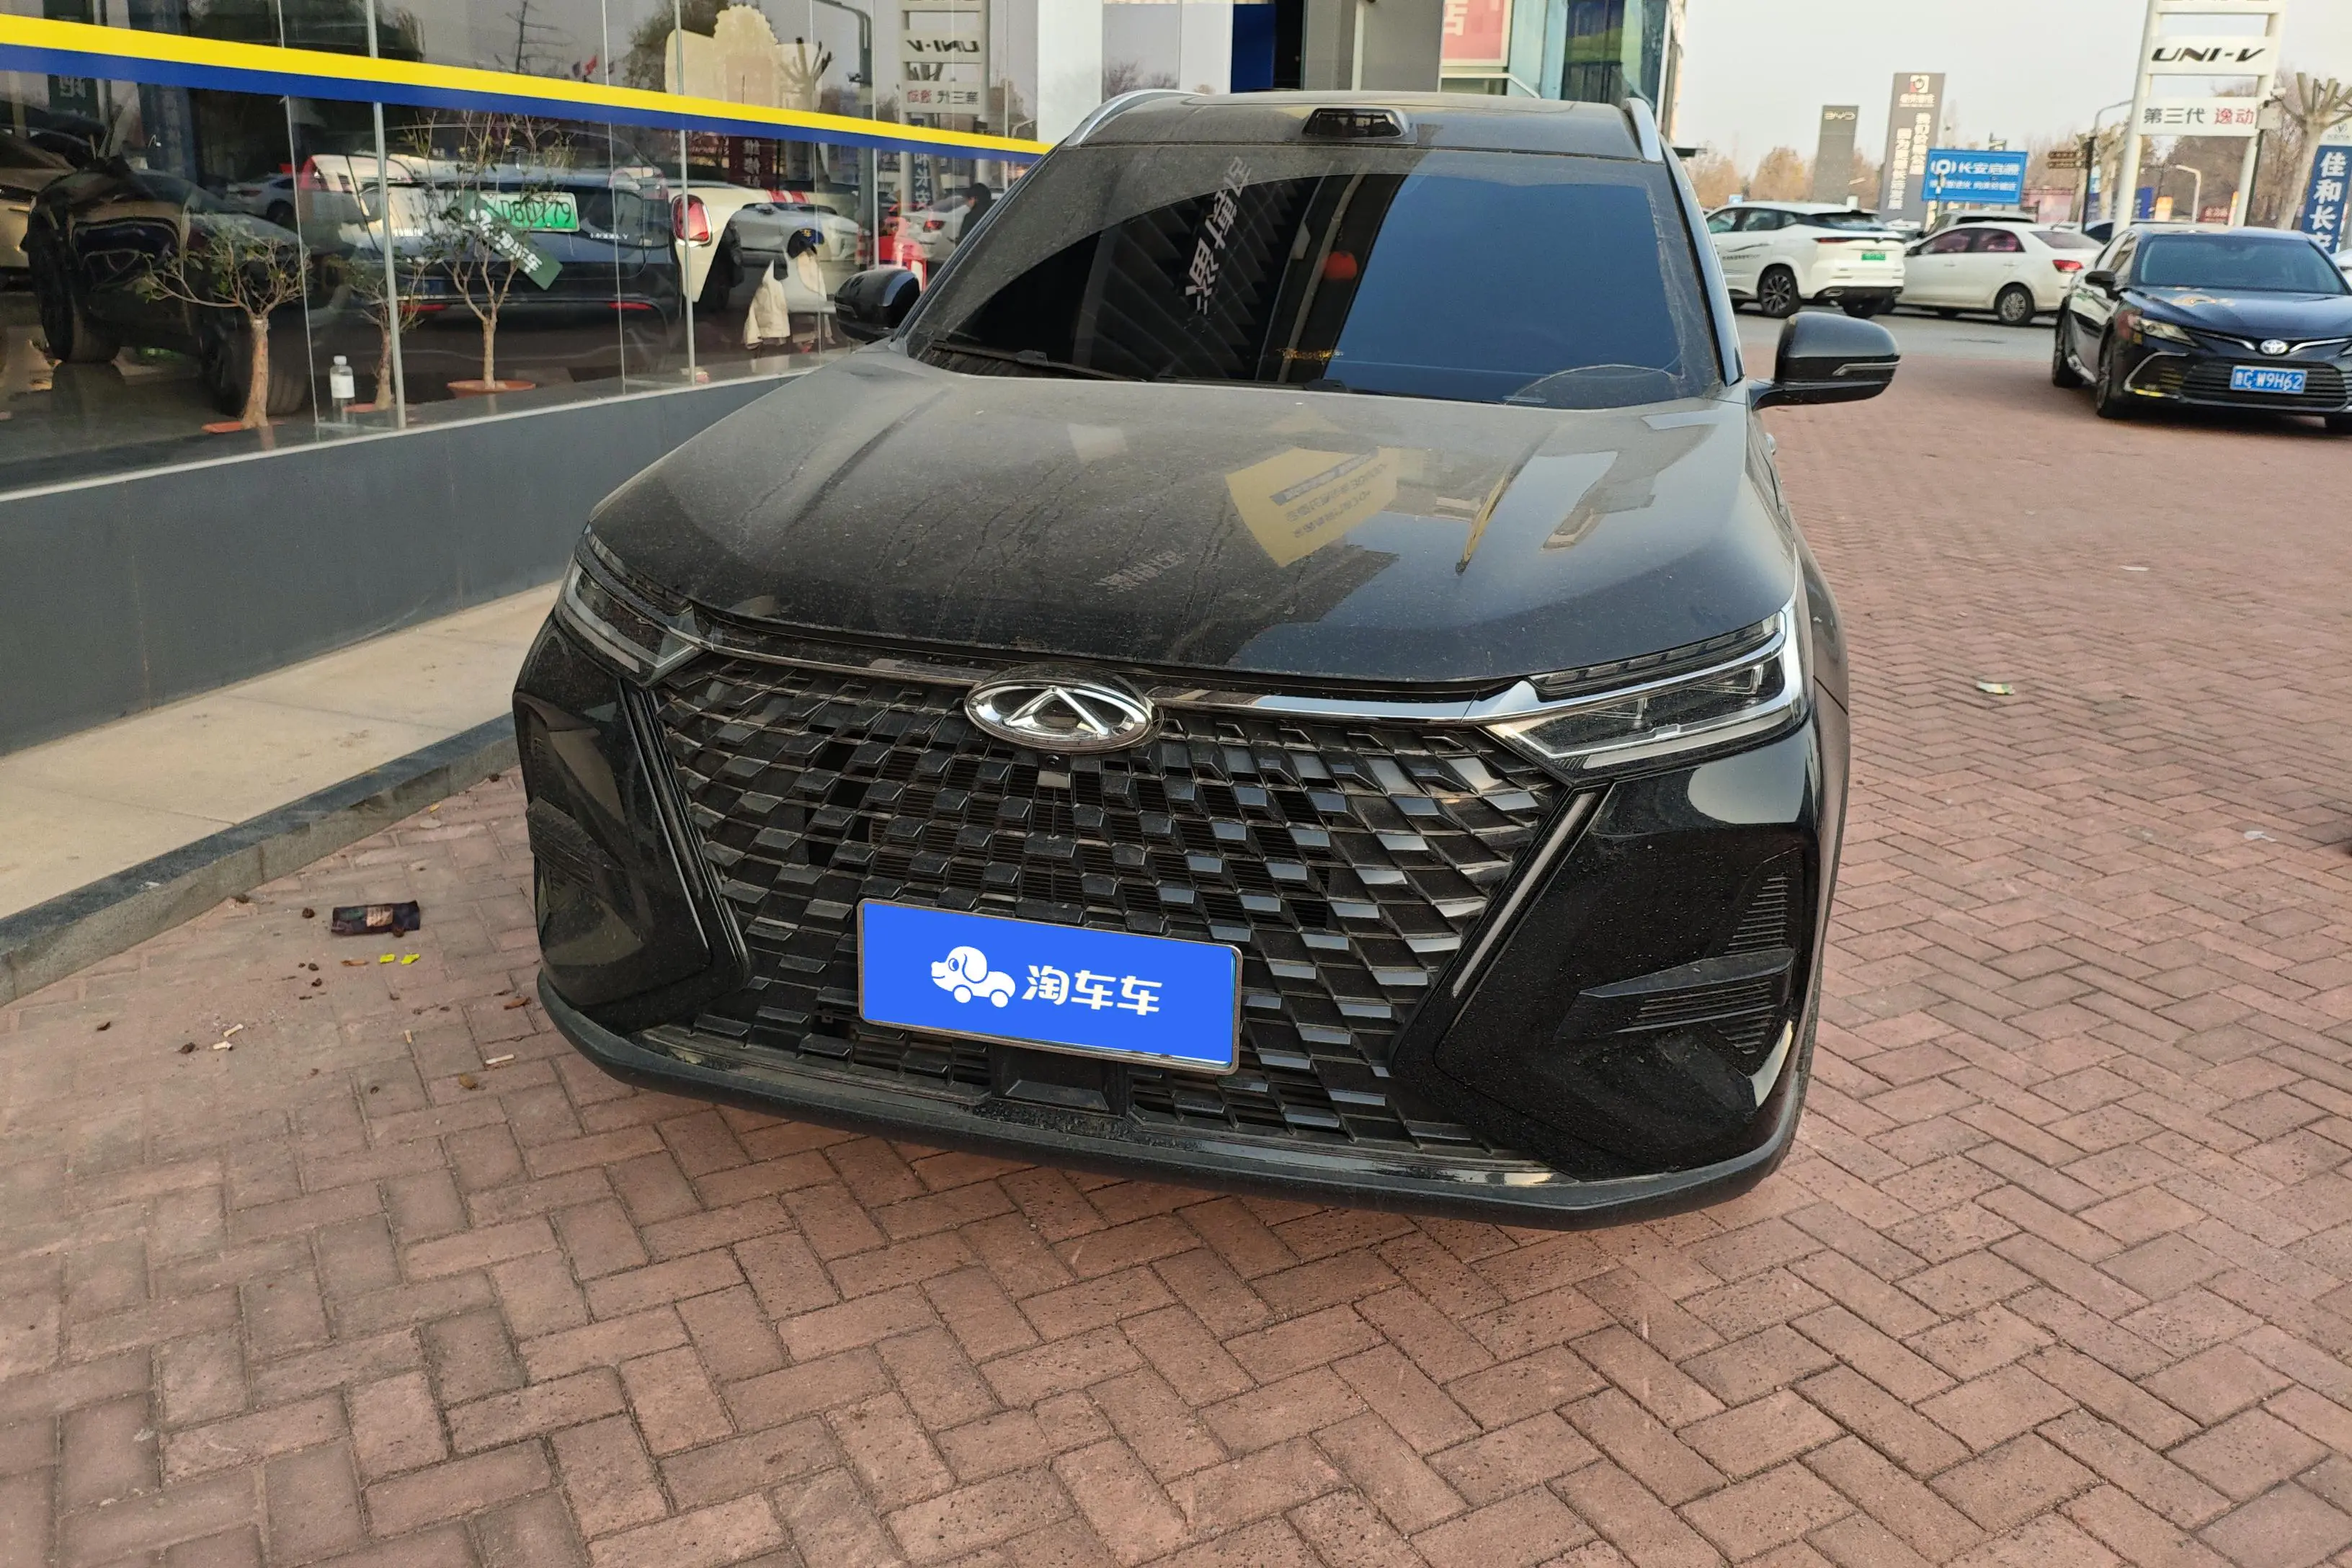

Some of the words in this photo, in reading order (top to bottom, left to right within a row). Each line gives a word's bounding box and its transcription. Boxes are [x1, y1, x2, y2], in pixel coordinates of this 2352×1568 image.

[2151, 47, 2266, 62] UNI-V
[2143, 107, 2206, 124] 第三代
[2213, 107, 2255, 125] 逸动
